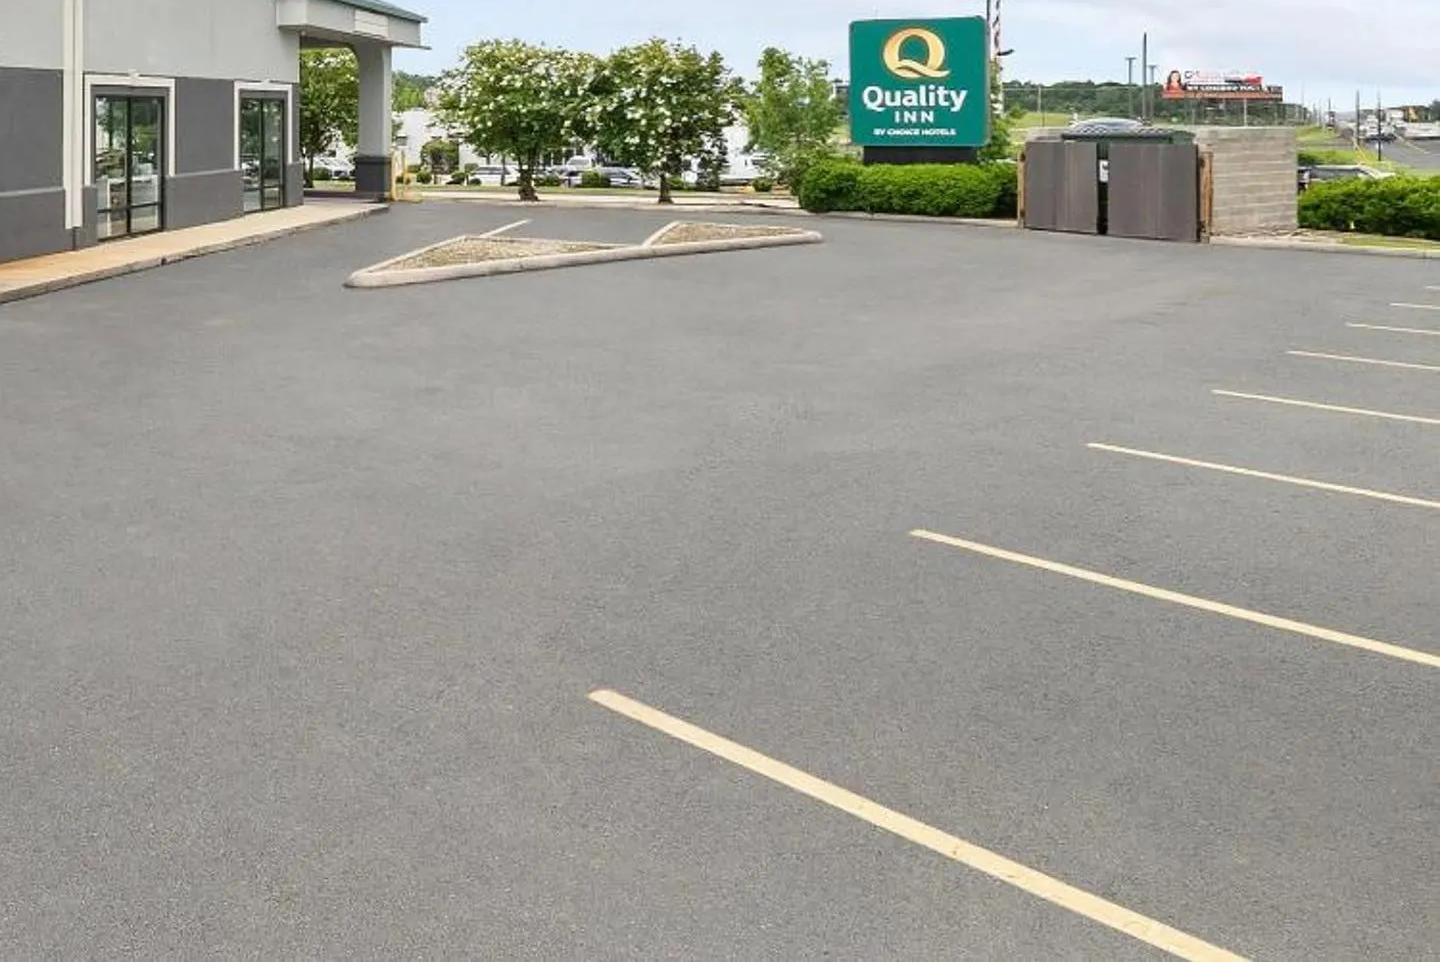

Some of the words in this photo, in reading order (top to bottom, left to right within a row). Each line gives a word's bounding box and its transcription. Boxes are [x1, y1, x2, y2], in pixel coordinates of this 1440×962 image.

[883, 28, 951, 78] Q
[862, 85, 968, 112] Quality
[894, 110, 935, 123] INN
[873, 128, 886, 136] BY
[886, 128, 920, 136] CHOICE
[921, 128, 957, 136] HOTELS
